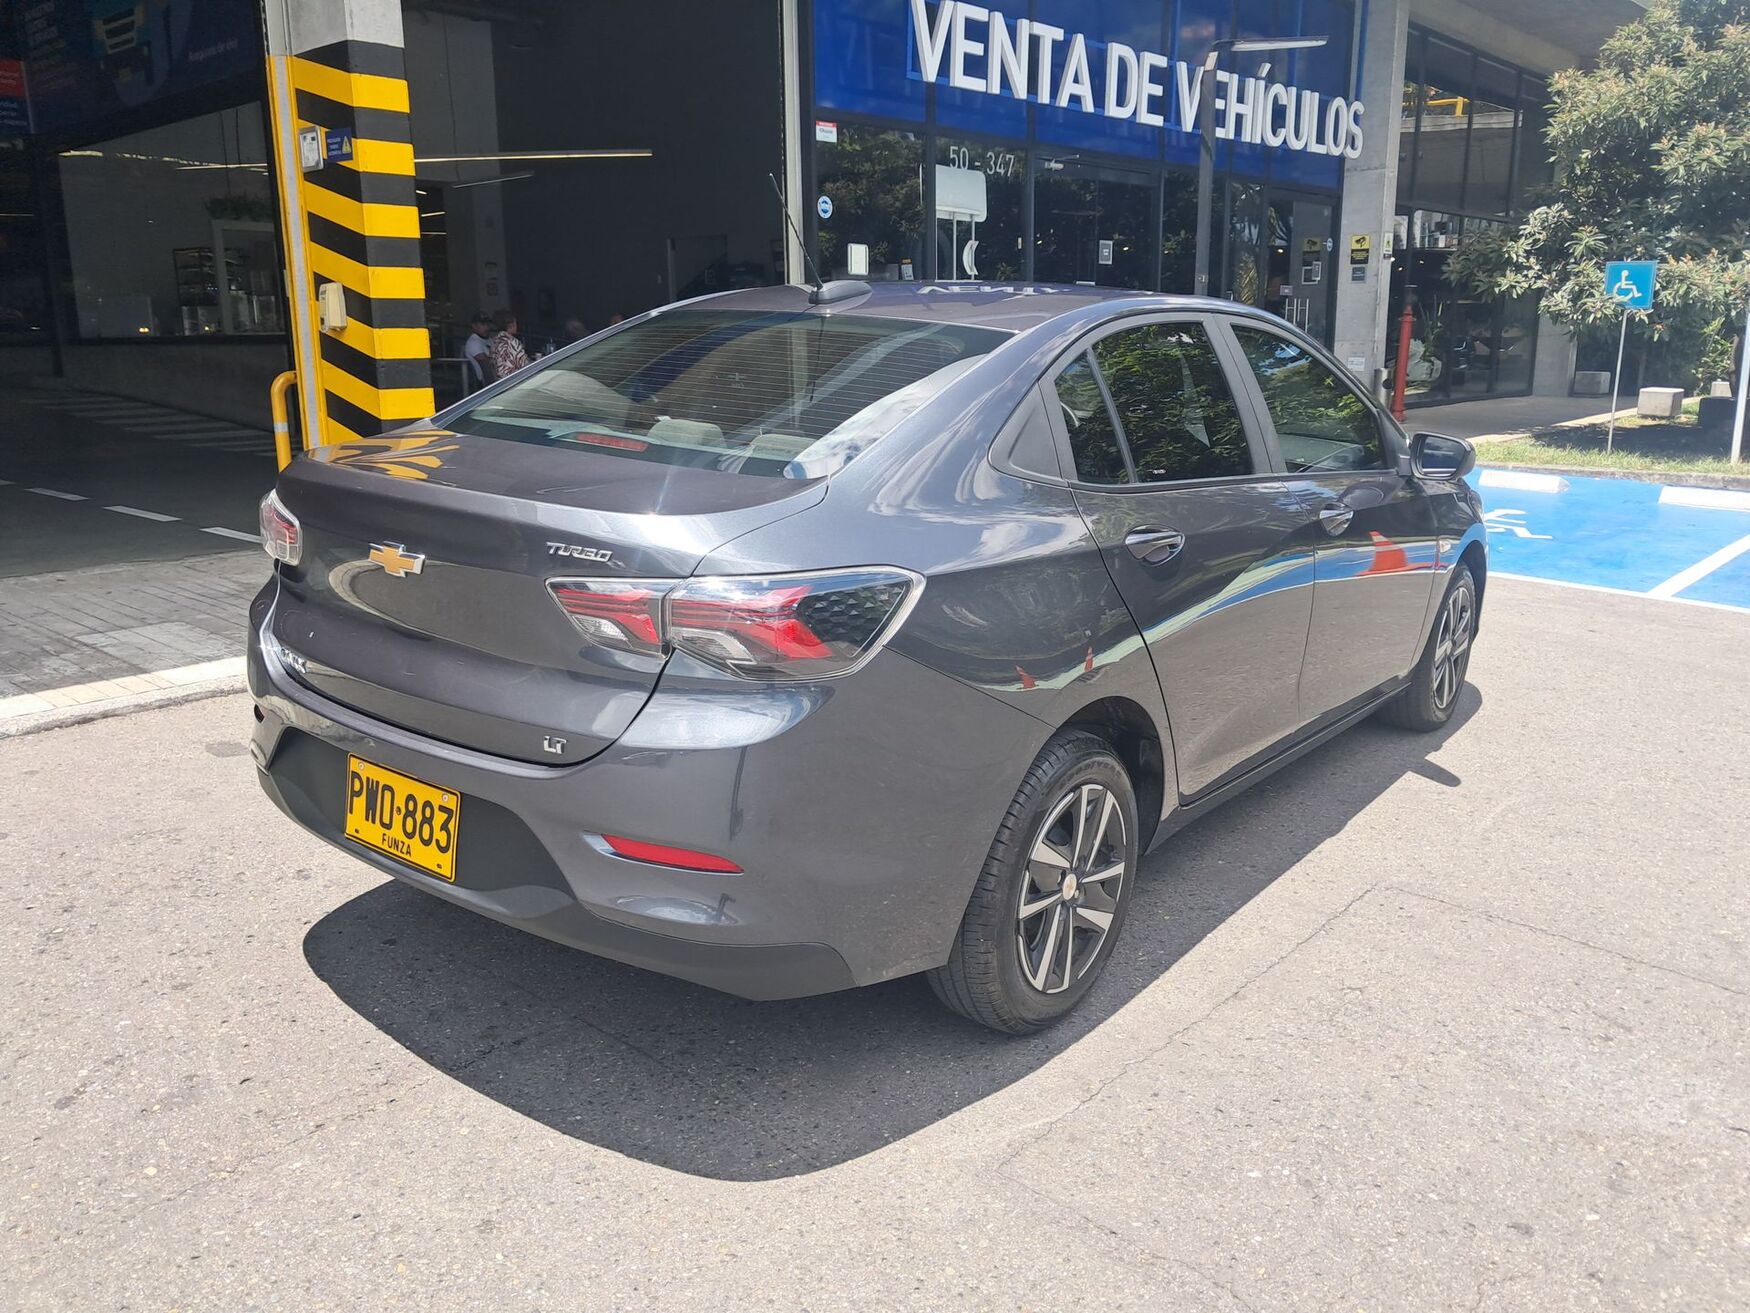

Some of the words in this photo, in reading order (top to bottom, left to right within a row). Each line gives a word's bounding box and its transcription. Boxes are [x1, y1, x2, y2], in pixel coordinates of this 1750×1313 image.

[910, 0, 1095, 113] VENTA
[1104, 42, 1168, 127] DE
[949, 145, 969, 171] 50
[986, 151, 1015, 177] 347
[546, 541, 613, 563] TURBO
[543, 735, 567, 755] LT
[381, 833, 412, 857] FUNZA
